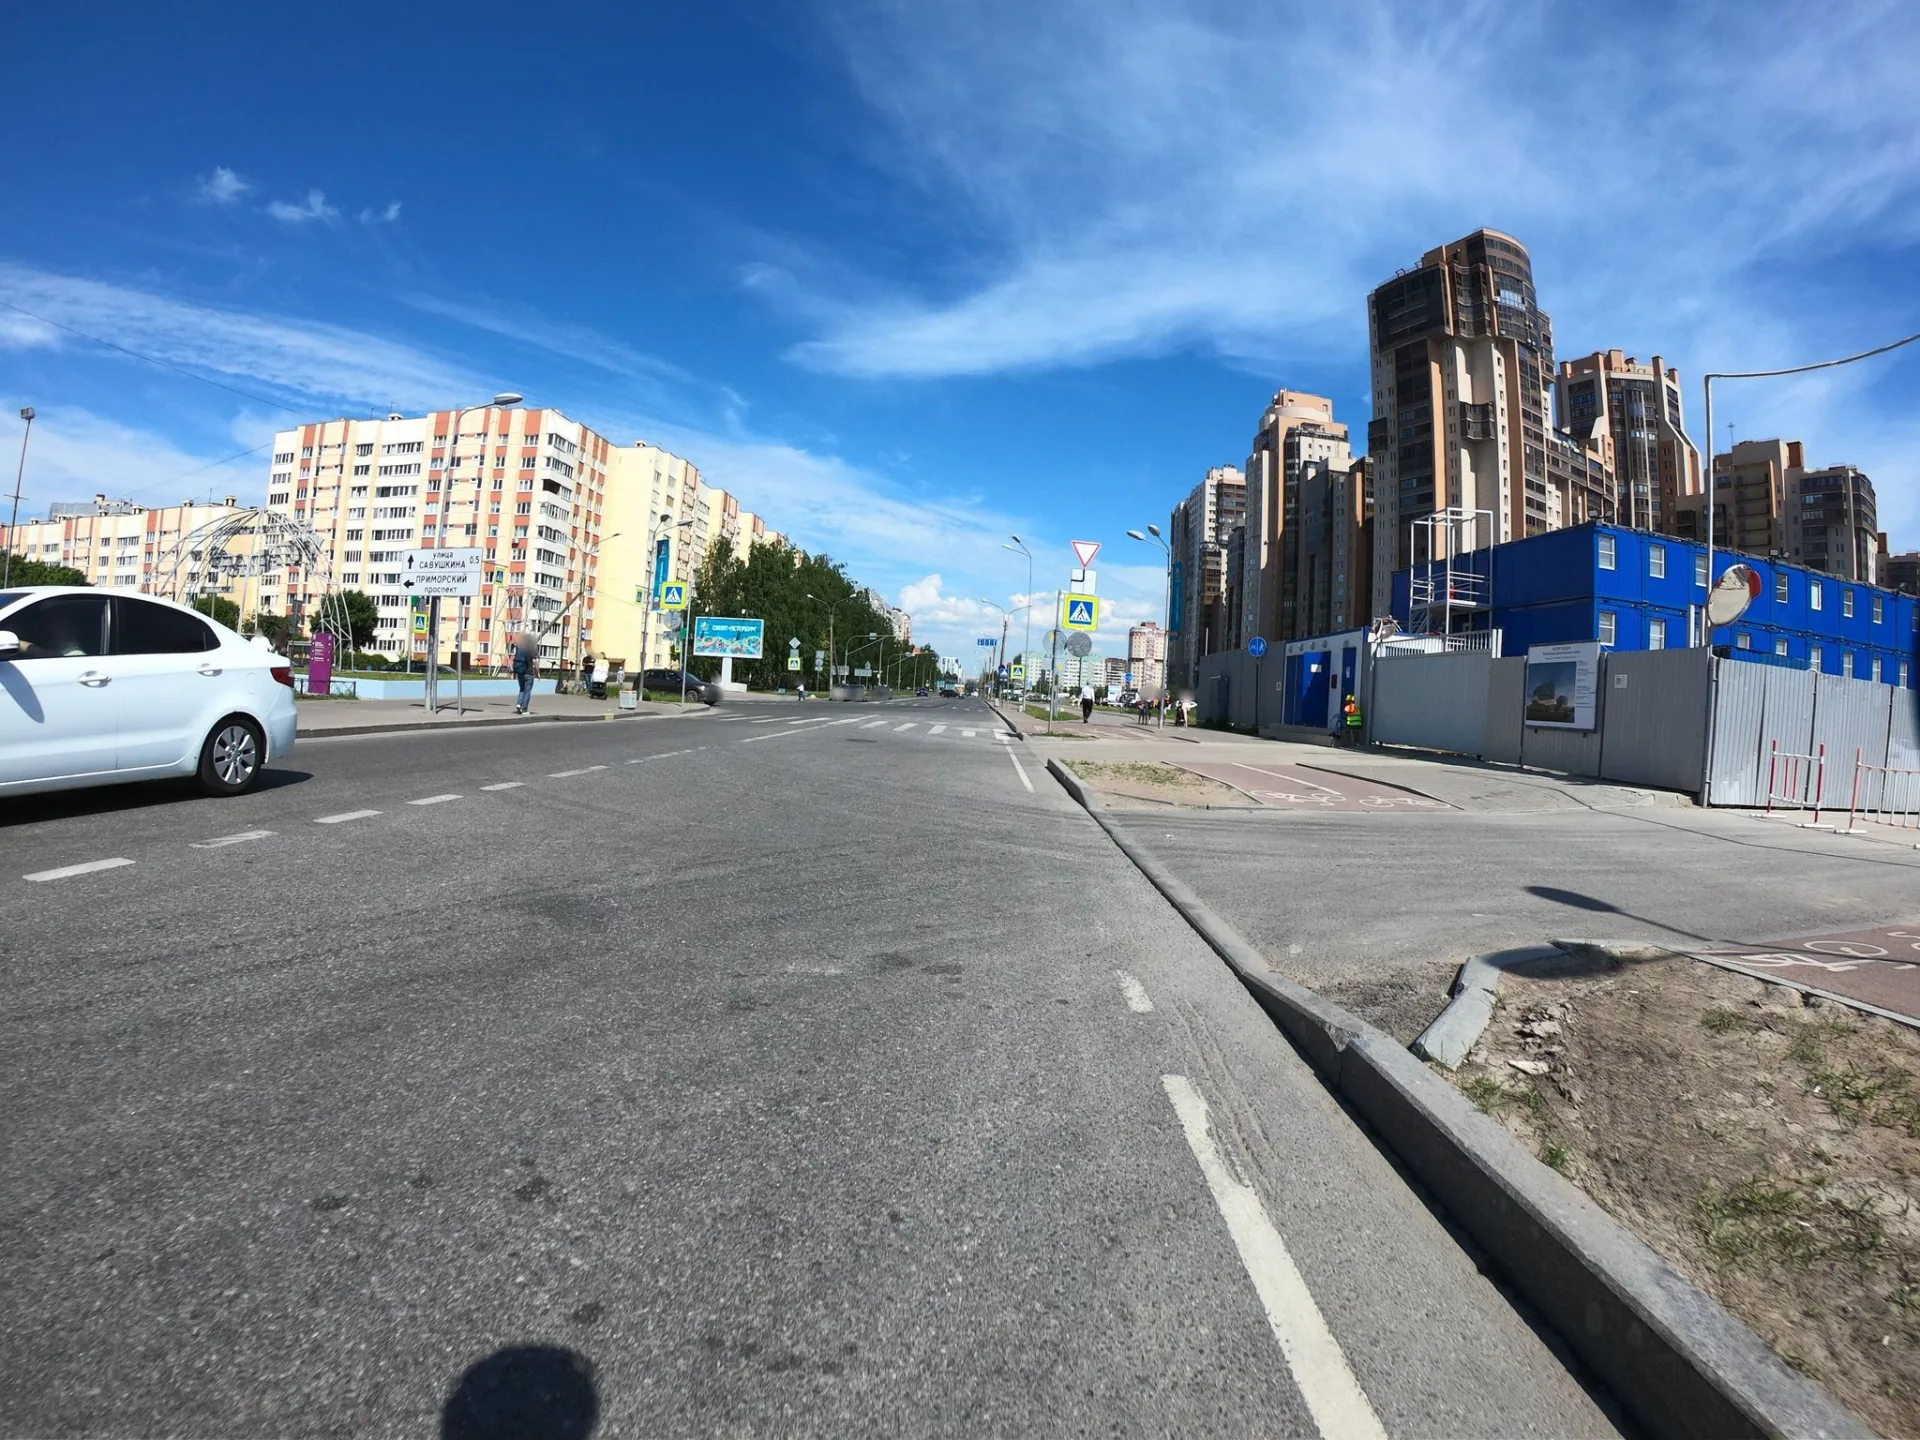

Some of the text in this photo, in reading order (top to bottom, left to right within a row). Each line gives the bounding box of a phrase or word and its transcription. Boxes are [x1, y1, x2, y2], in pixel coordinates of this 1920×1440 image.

[433, 552, 453, 560] улица
[419, 561, 466, 569] САВУШКИНА
[416, 573, 467, 584] ПРИМОРСКИЙ
